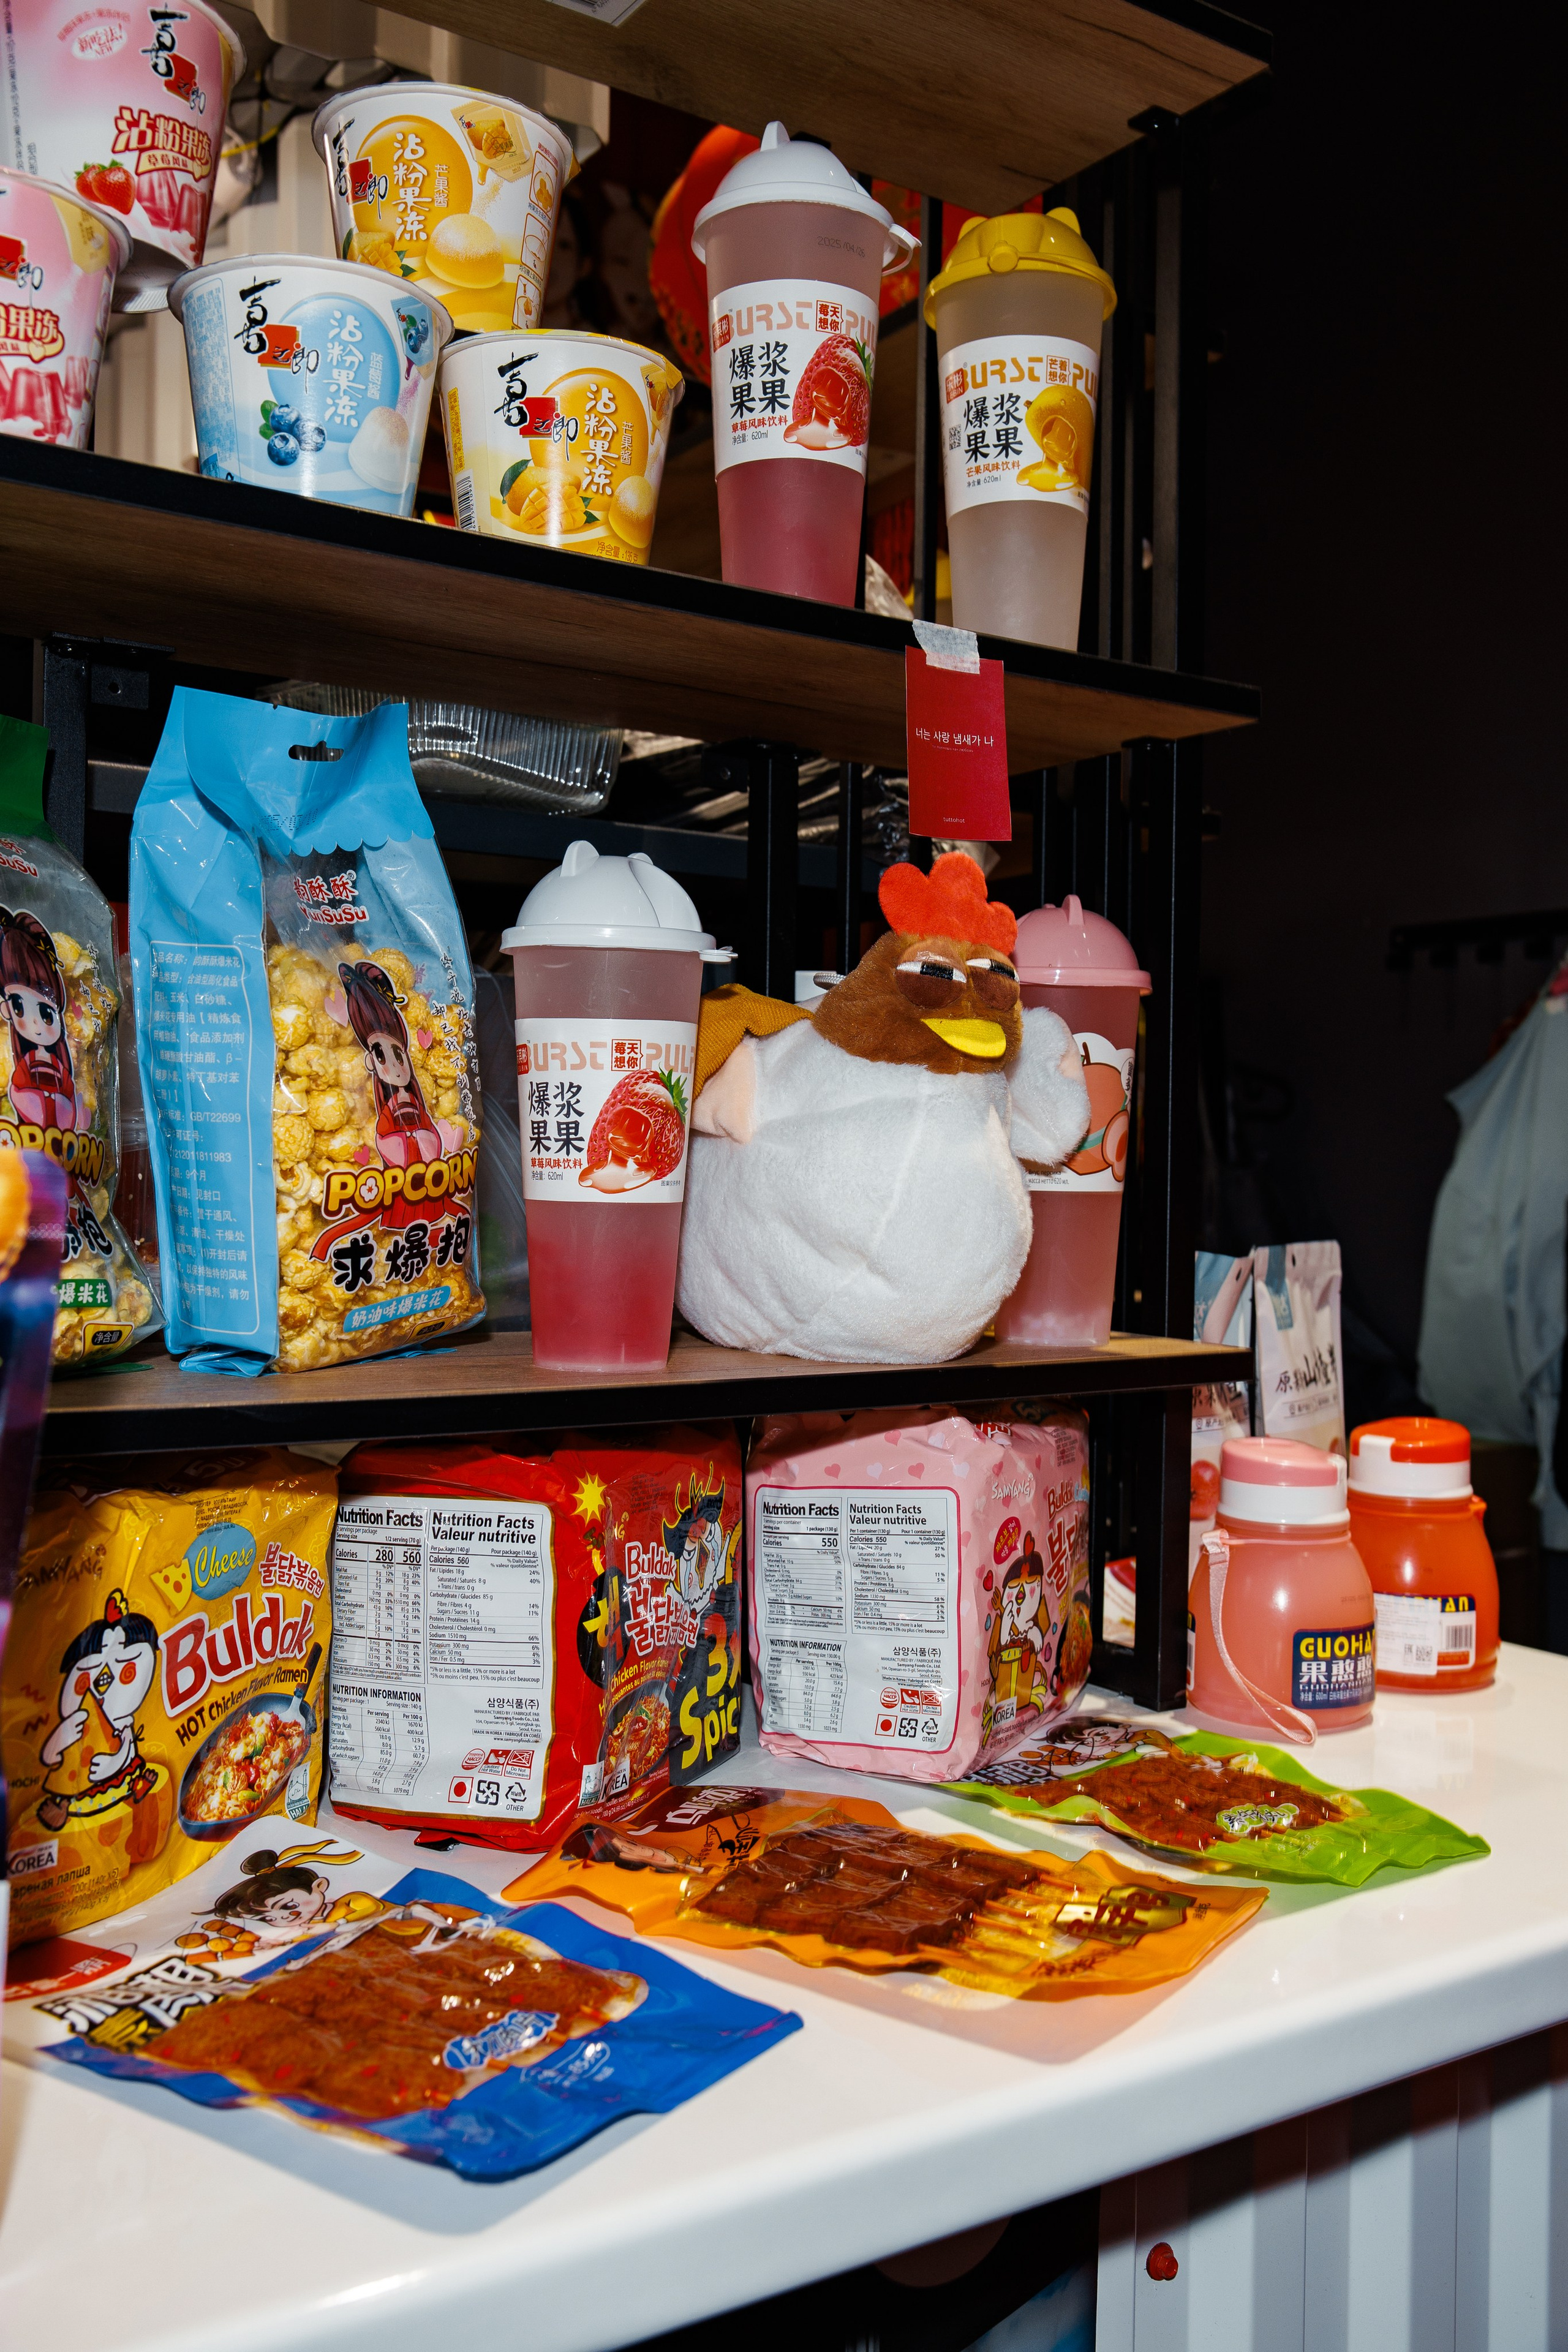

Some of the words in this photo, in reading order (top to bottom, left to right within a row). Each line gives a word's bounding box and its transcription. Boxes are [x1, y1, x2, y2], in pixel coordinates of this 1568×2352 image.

[113, 106, 211, 164] 沾粉果冻
[392, 132, 432, 241] 沾粉果冻
[434, 163, 450, 209] 芒果酱
[816, 235, 865, 258] 2025/04/26
[323, 310, 366, 428] 沾粉果冻
[729, 341, 791, 385] 爆浆
[729, 377, 791, 420] 果果
[947, 387, 964, 402] LEBIN
[963, 393, 1023, 432] 爆浆
[731, 415, 789, 434] 草莓风味饮料
[580, 383, 619, 496] 沾粉果冻
[620, 420, 634, 466] 芒果酱
[963, 426, 1023, 464] 果果
[966, 460, 1021, 478] 芒果风味饮料
[916, 727, 930, 741] 너는
[933, 731, 950, 744] 사랑
[953, 733, 981, 746] 냄새가
[984, 735, 994, 747] 나
[294, 876, 359, 902] 韵酥酥
[298, 903, 369, 924] YunSuSu
[193, 956, 240, 968] 韵酥酥爆米花
[187, 973, 238, 987] 含油型膨化食品
[528, 1081, 586, 1118] 爆浆
[190, 1112, 241, 1123] GB/T22699
[529, 1119, 586, 1156] 果果
[0, 1123, 105, 1188] OPCORN
[531, 1157, 583, 1170] 草莓风味饮料
[325, 1147, 479, 1216] POPCORN
[196, 1189, 221, 1201] 见封口
[333, 1216, 469, 1291] 求爆抱
[59, 1281, 108, 1304] 爆米花
[352, 1290, 444, 1328] 奶油味爆米花
[94, 1330, 120, 1344] 净含量
[992, 1478, 1032, 1501] SAMYANG
[337, 1506, 383, 1525] Nutrition
[386, 1509, 423, 1527] Facts
[763, 1501, 805, 1516] Nutrition
[809, 1503, 839, 1516] Facts
[850, 1504, 894, 1514] Nutrition
[896, 1504, 922, 1514] Facts
[850, 1515, 881, 1525] Valeur
[883, 1515, 927, 1525] nutritive
[432, 1512, 492, 1528] Nutrition
[497, 1515, 535, 1529] Facts
[432, 1526, 475, 1541] Valeur
[478, 1529, 536, 1544] nutritive
[763, 1538, 782, 1547] Calories
[821, 1538, 838, 1547] 550
[995, 1528, 1009, 1554] 까르보
[194, 1546, 254, 1588] Cheese
[336, 1548, 358, 1559] Calories
[375, 1549, 393, 1562] 280
[403, 1551, 421, 1564] 560
[429, 1555, 454, 1565] Calories
[457, 1556, 469, 1565] 560
[625, 1542, 676, 1583] Buldak
[23, 1556, 103, 1589] AMYANG
[260, 1542, 324, 1597] 불닭볶음면
[624, 1583, 699, 1656] 불닭볶음면
[161, 1595, 314, 1713] Buldak
[770, 1638, 797, 1648] NUTRITION
[799, 1640, 842, 1652] INFORMATION
[893, 1646, 941, 1657] 삼양식품(주)
[1300, 1630, 1374, 1659] GUOHA
[518, 1675, 540, 1684] beaucoup
[611, 1663, 638, 1692] Chicken
[639, 1659, 657, 1674] Flavor
[333, 1683, 368, 1697] NUTRITION
[370, 1689, 421, 1702] INFORMATION
[487, 1697, 539, 1710] 삼양식품(주)
[176, 1705, 208, 1747] HOT
[208, 1685, 248, 1720] Chicken
[247, 1672, 275, 1698] Flavor
[275, 1666, 308, 1684] Ramen
[993, 1706, 1015, 1726] KOREA
[680, 1687, 741, 1770] Spic
[581, 1796, 598, 1807] HALAL
[13, 1879, 53, 1899] ареная
[57, 1865, 91, 1886] лапша
